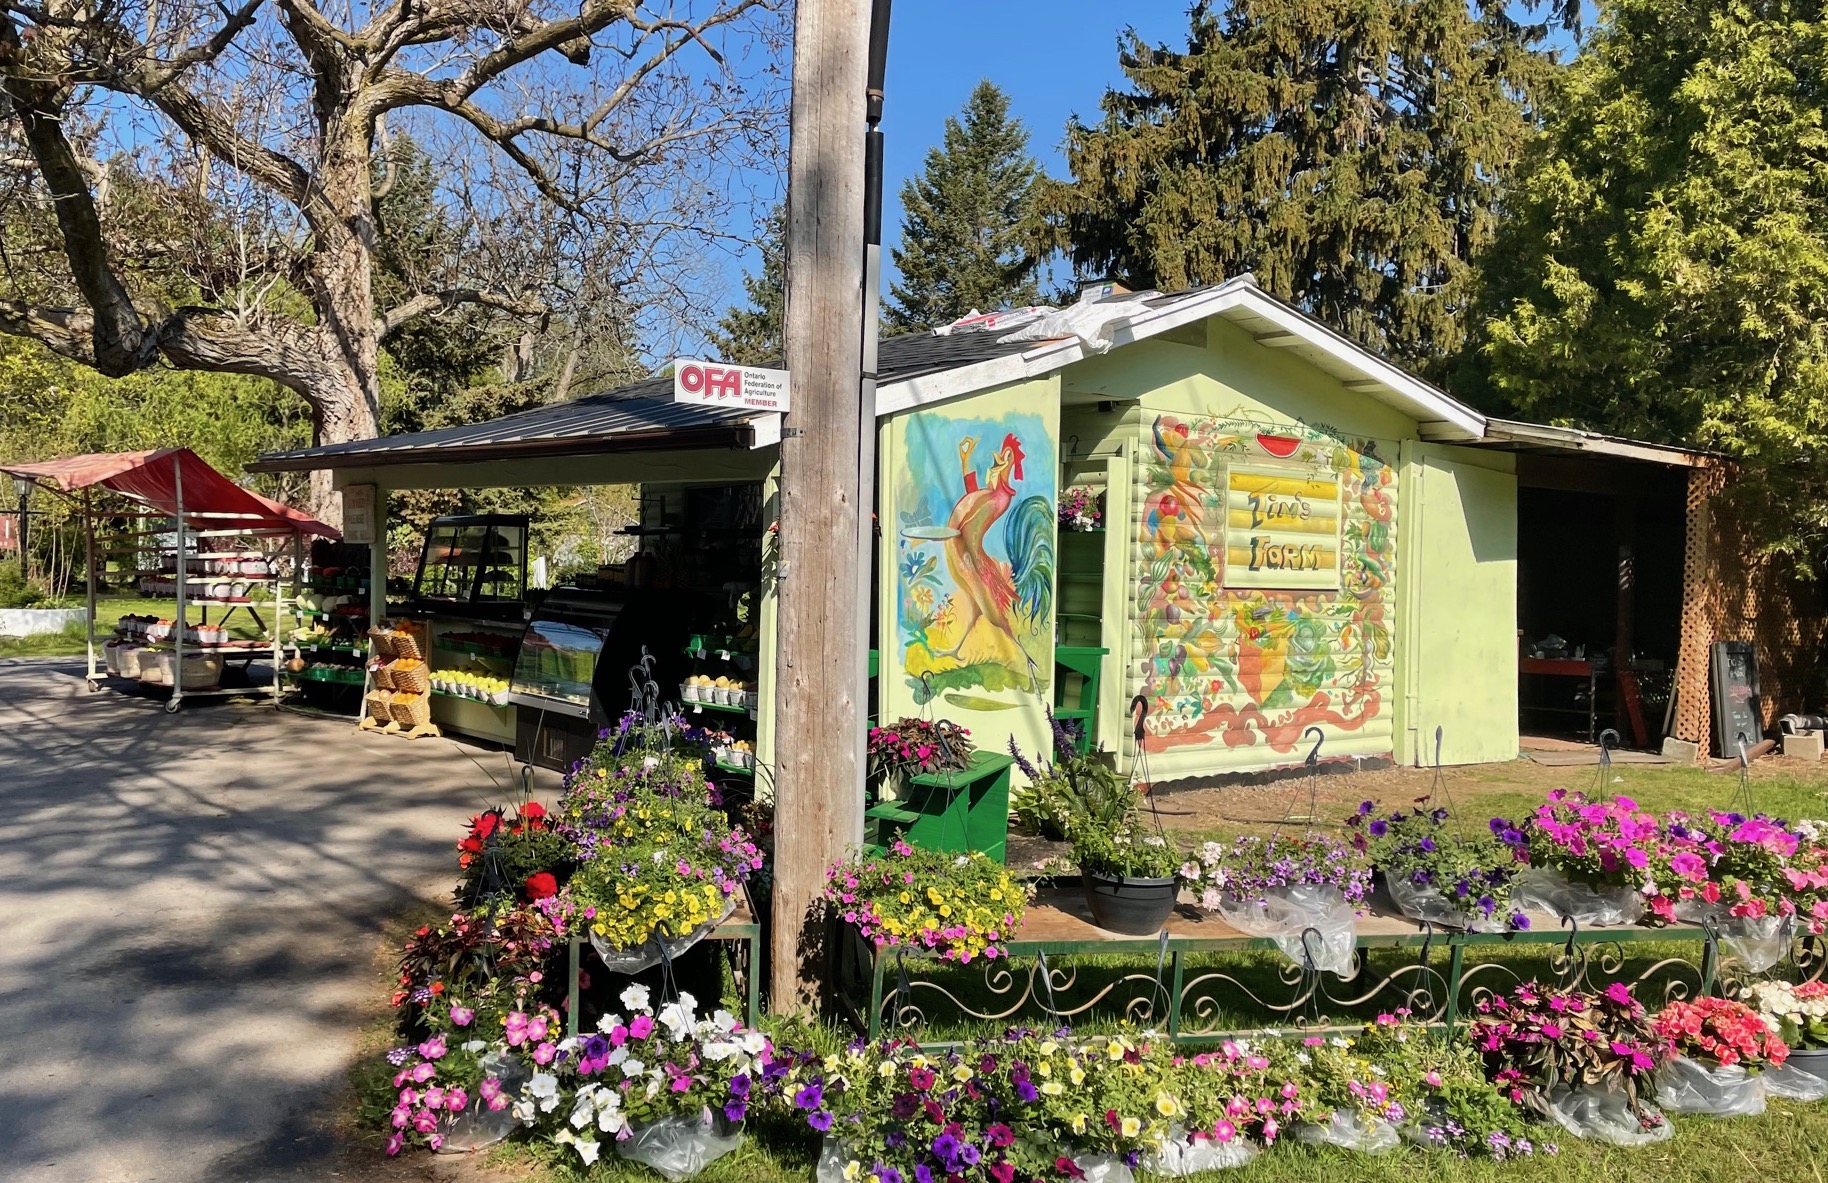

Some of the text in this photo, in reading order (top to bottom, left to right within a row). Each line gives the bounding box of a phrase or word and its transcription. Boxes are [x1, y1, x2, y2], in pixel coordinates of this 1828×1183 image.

[744, 371, 766, 380] Ontario
[680, 364, 742, 399] OFA
[744, 379, 775, 389] Federation
[744, 388, 777, 398] Agriculture
[744, 398, 778, 408] MEMBER
